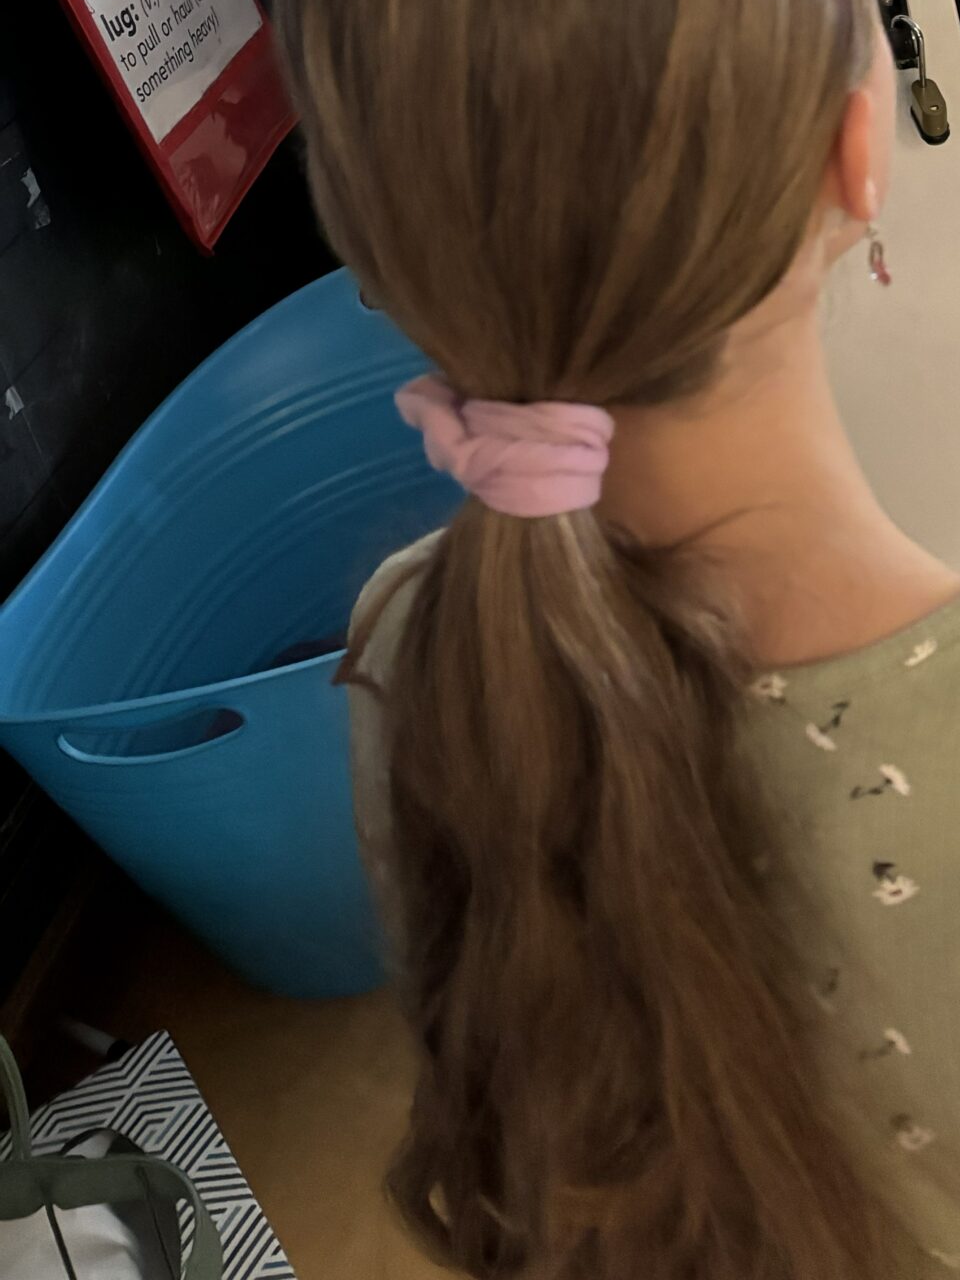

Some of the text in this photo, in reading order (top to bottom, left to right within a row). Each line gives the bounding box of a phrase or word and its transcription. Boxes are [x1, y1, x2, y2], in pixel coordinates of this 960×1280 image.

[100, 3, 140, 42] lug:
[120, 52, 137, 72] to
[137, 23, 161, 66] pull
[161, 17, 173, 37] or
[136, 5, 220, 102] something heavy)
